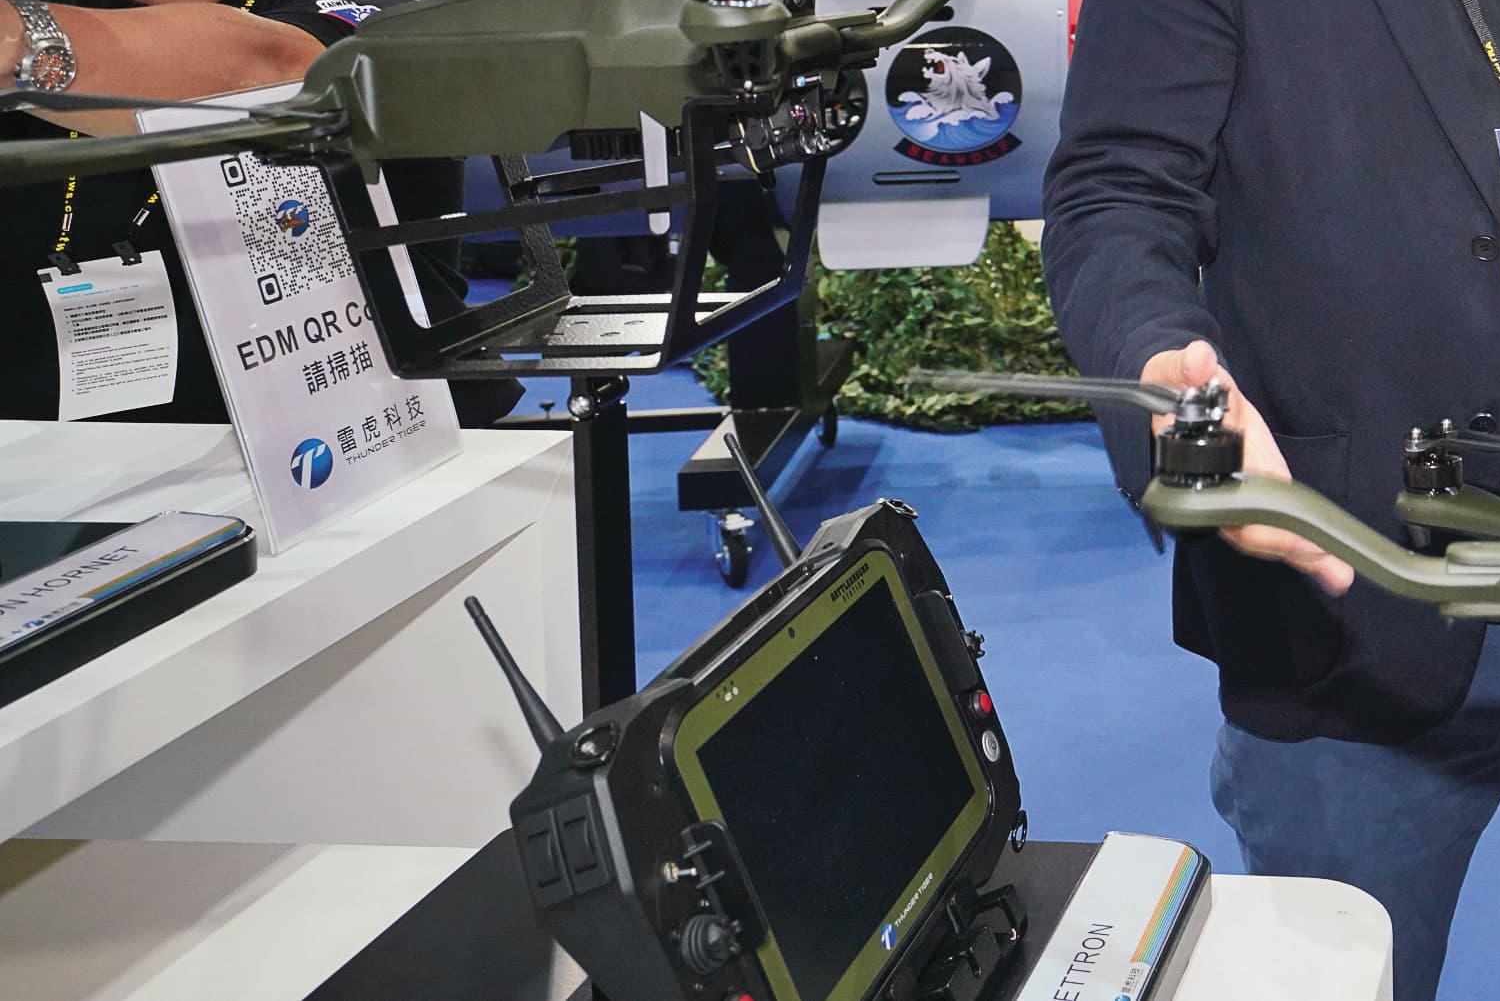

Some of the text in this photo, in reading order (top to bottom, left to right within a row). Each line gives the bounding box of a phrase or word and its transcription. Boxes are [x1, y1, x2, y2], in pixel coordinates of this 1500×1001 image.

[236, 325, 300, 372] EDM
[303, 309, 343, 344] QR
[302, 340, 374, 396] 請掃描
[336, 394, 425, 455] 雷虎科技
[345, 420, 427, 466] THUNDER TIGER
[20, 545, 140, 599] HORNET
